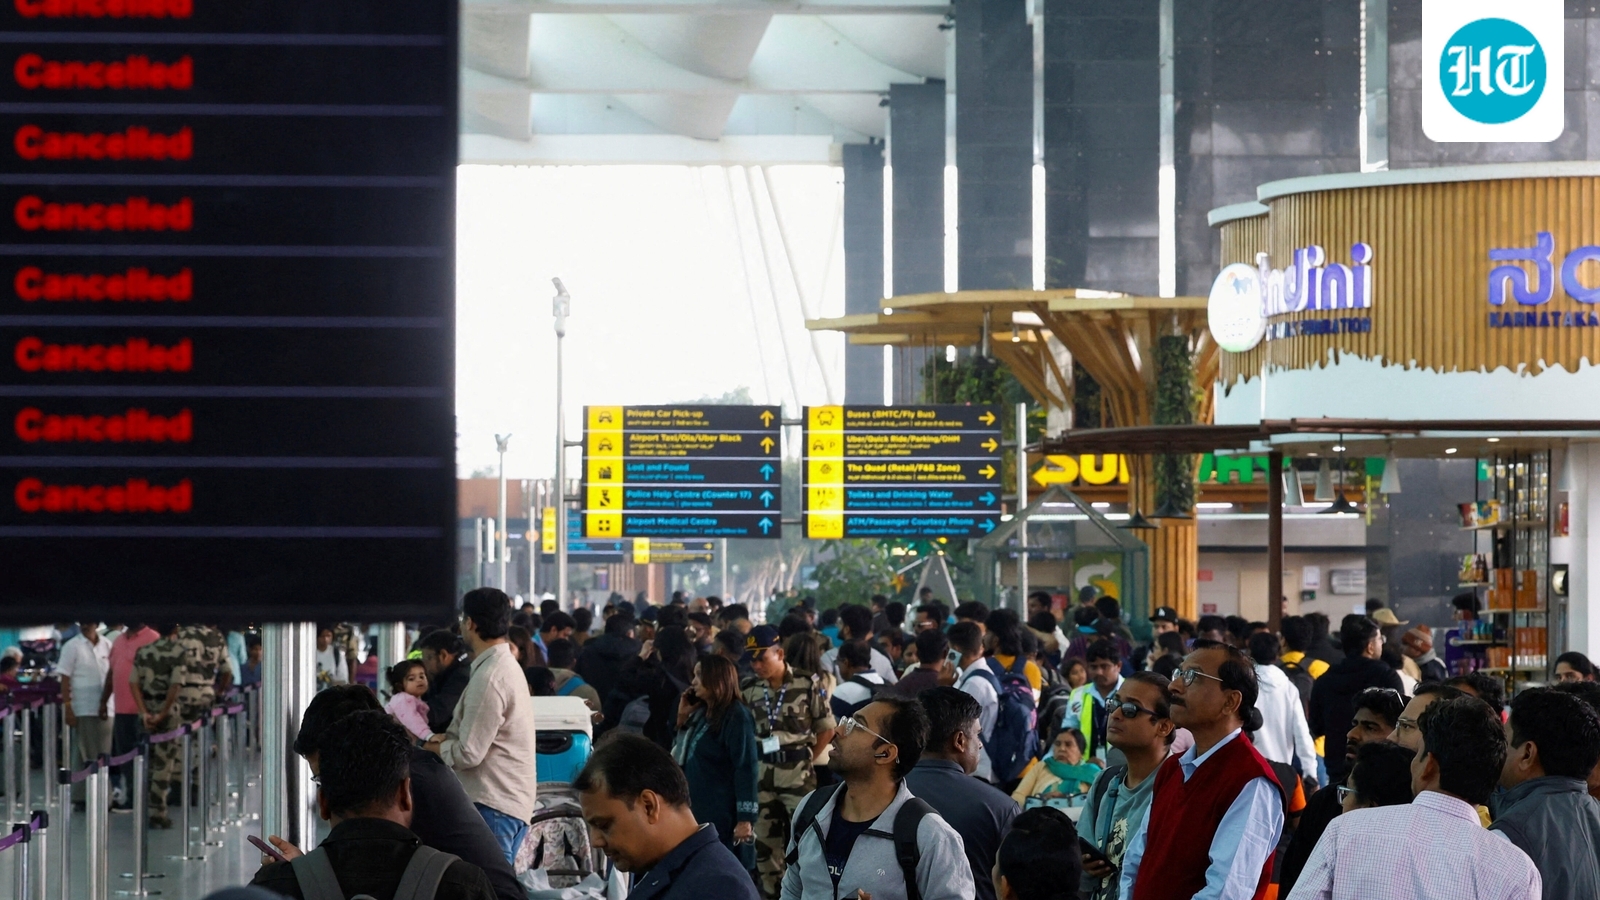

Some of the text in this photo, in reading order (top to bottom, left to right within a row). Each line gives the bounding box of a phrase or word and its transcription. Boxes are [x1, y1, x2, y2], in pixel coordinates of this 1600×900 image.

[15, 55, 192, 89] Cancelled
[15, 126, 192, 159] Cancelled
[15, 197, 192, 230] Cancelled
[15, 268, 192, 301] Cancelled
[15, 338, 192, 371] Cancelled
[627, 409, 704, 419] Private Car Pick-up
[847, 410, 936, 420] Buses (BMTC/Fly Bus)
[15, 409, 192, 441] Cancelled
[629, 434, 659, 443] Airport
[719, 434, 742, 443] Black
[846, 435, 889, 444] Uber/Quick
[626, 463, 690, 472] Lost and Found
[847, 463, 961, 474] The Quad (Retail/F&B Zone)
[15, 479, 192, 511] Cancelled
[626, 490, 753, 501] Police Help Centre (Counter 17)
[847, 490, 953, 501] Toilets and Drinking Water
[626, 517, 718, 527] Airport Medical Centre
[847, 517, 975, 528] ATM/Passenger Courtesy Phone
